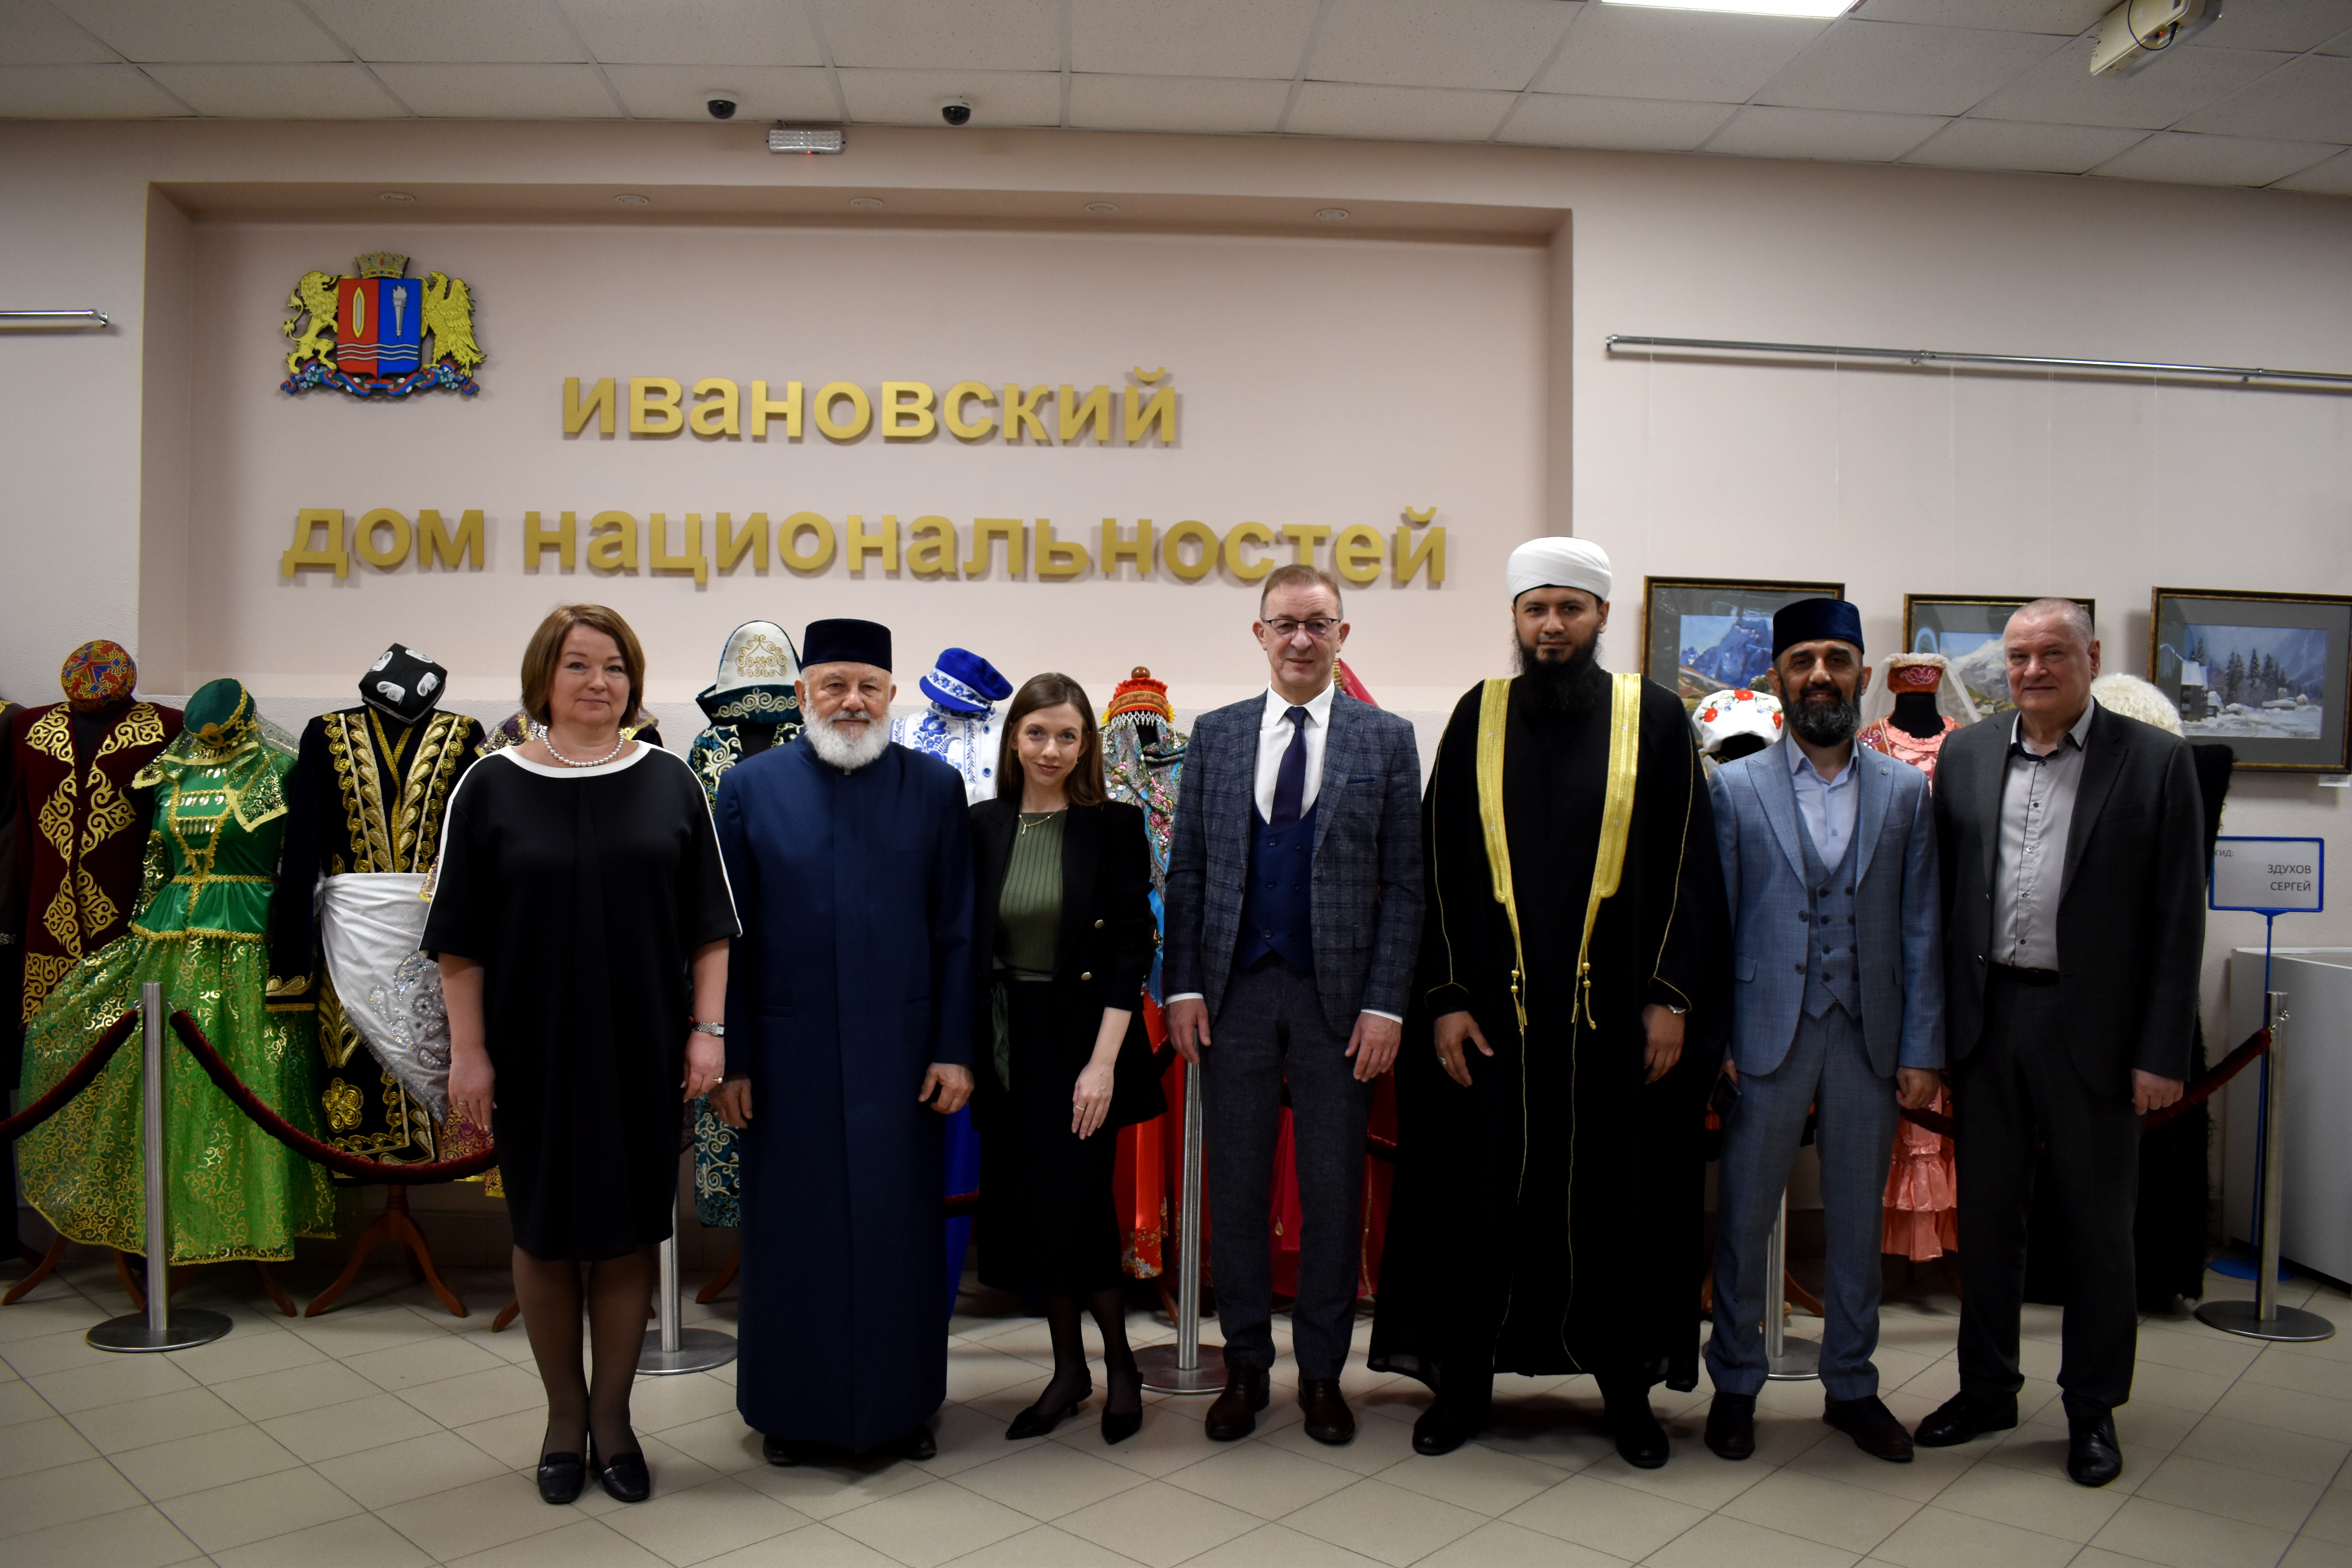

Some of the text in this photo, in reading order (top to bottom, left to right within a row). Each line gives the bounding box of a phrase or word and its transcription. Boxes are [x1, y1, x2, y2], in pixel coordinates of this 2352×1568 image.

[563, 366, 1176, 444] ивановский
[282, 506, 1446, 589] дом национальностей
[2267, 864, 2311, 875] ЗДУХОВ
[2270, 880, 2310, 891] СЕРГЕЙ
